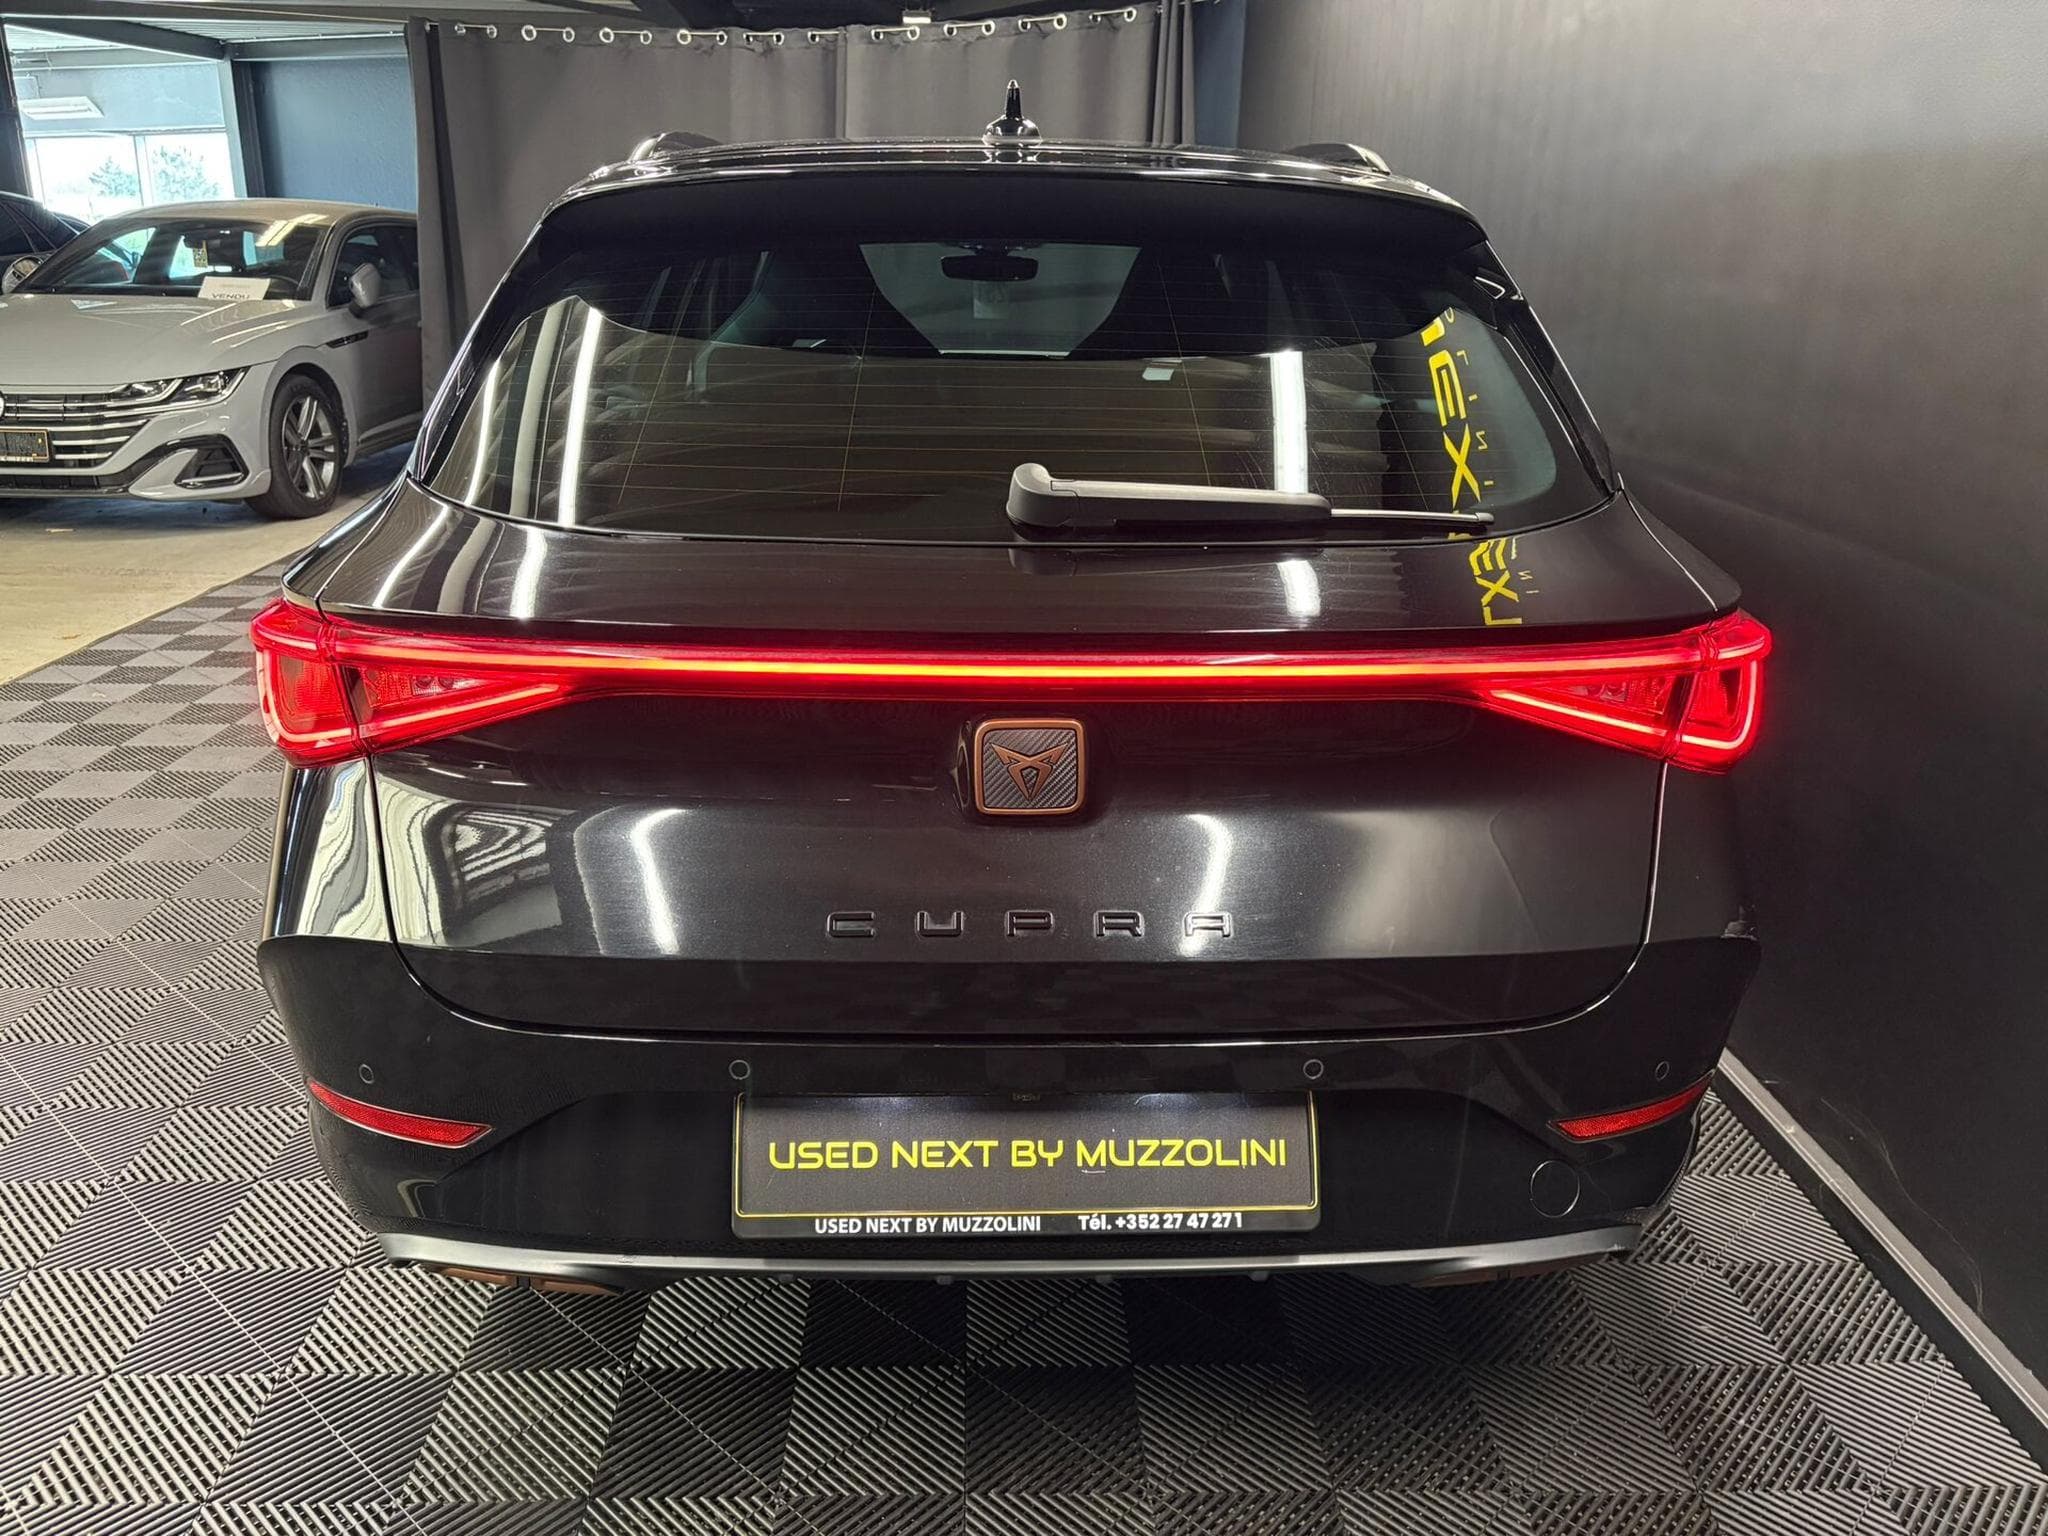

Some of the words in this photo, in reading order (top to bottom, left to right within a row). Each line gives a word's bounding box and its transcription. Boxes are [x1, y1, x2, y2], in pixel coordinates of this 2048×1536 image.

[826, 910, 1234, 938] CUPRA
[769, 1141, 878, 1169] USED
[891, 1140, 999, 1168] NEXT
[1011, 1139, 1064, 1168] BY
[1076, 1138, 1287, 1168] MUZZOLINI
[814, 1218, 862, 1234] USED
[866, 1217, 912, 1233] NEXT
[916, 1217, 938, 1232] BY
[942, 1216, 1041, 1232] MUZZOLINI
[1077, 1214, 1112, 1230] Tél.
[1115, 1213, 1160, 1230] +352
[1163, 1213, 1183, 1229] 27
[1186, 1213, 1209, 1228] 47
